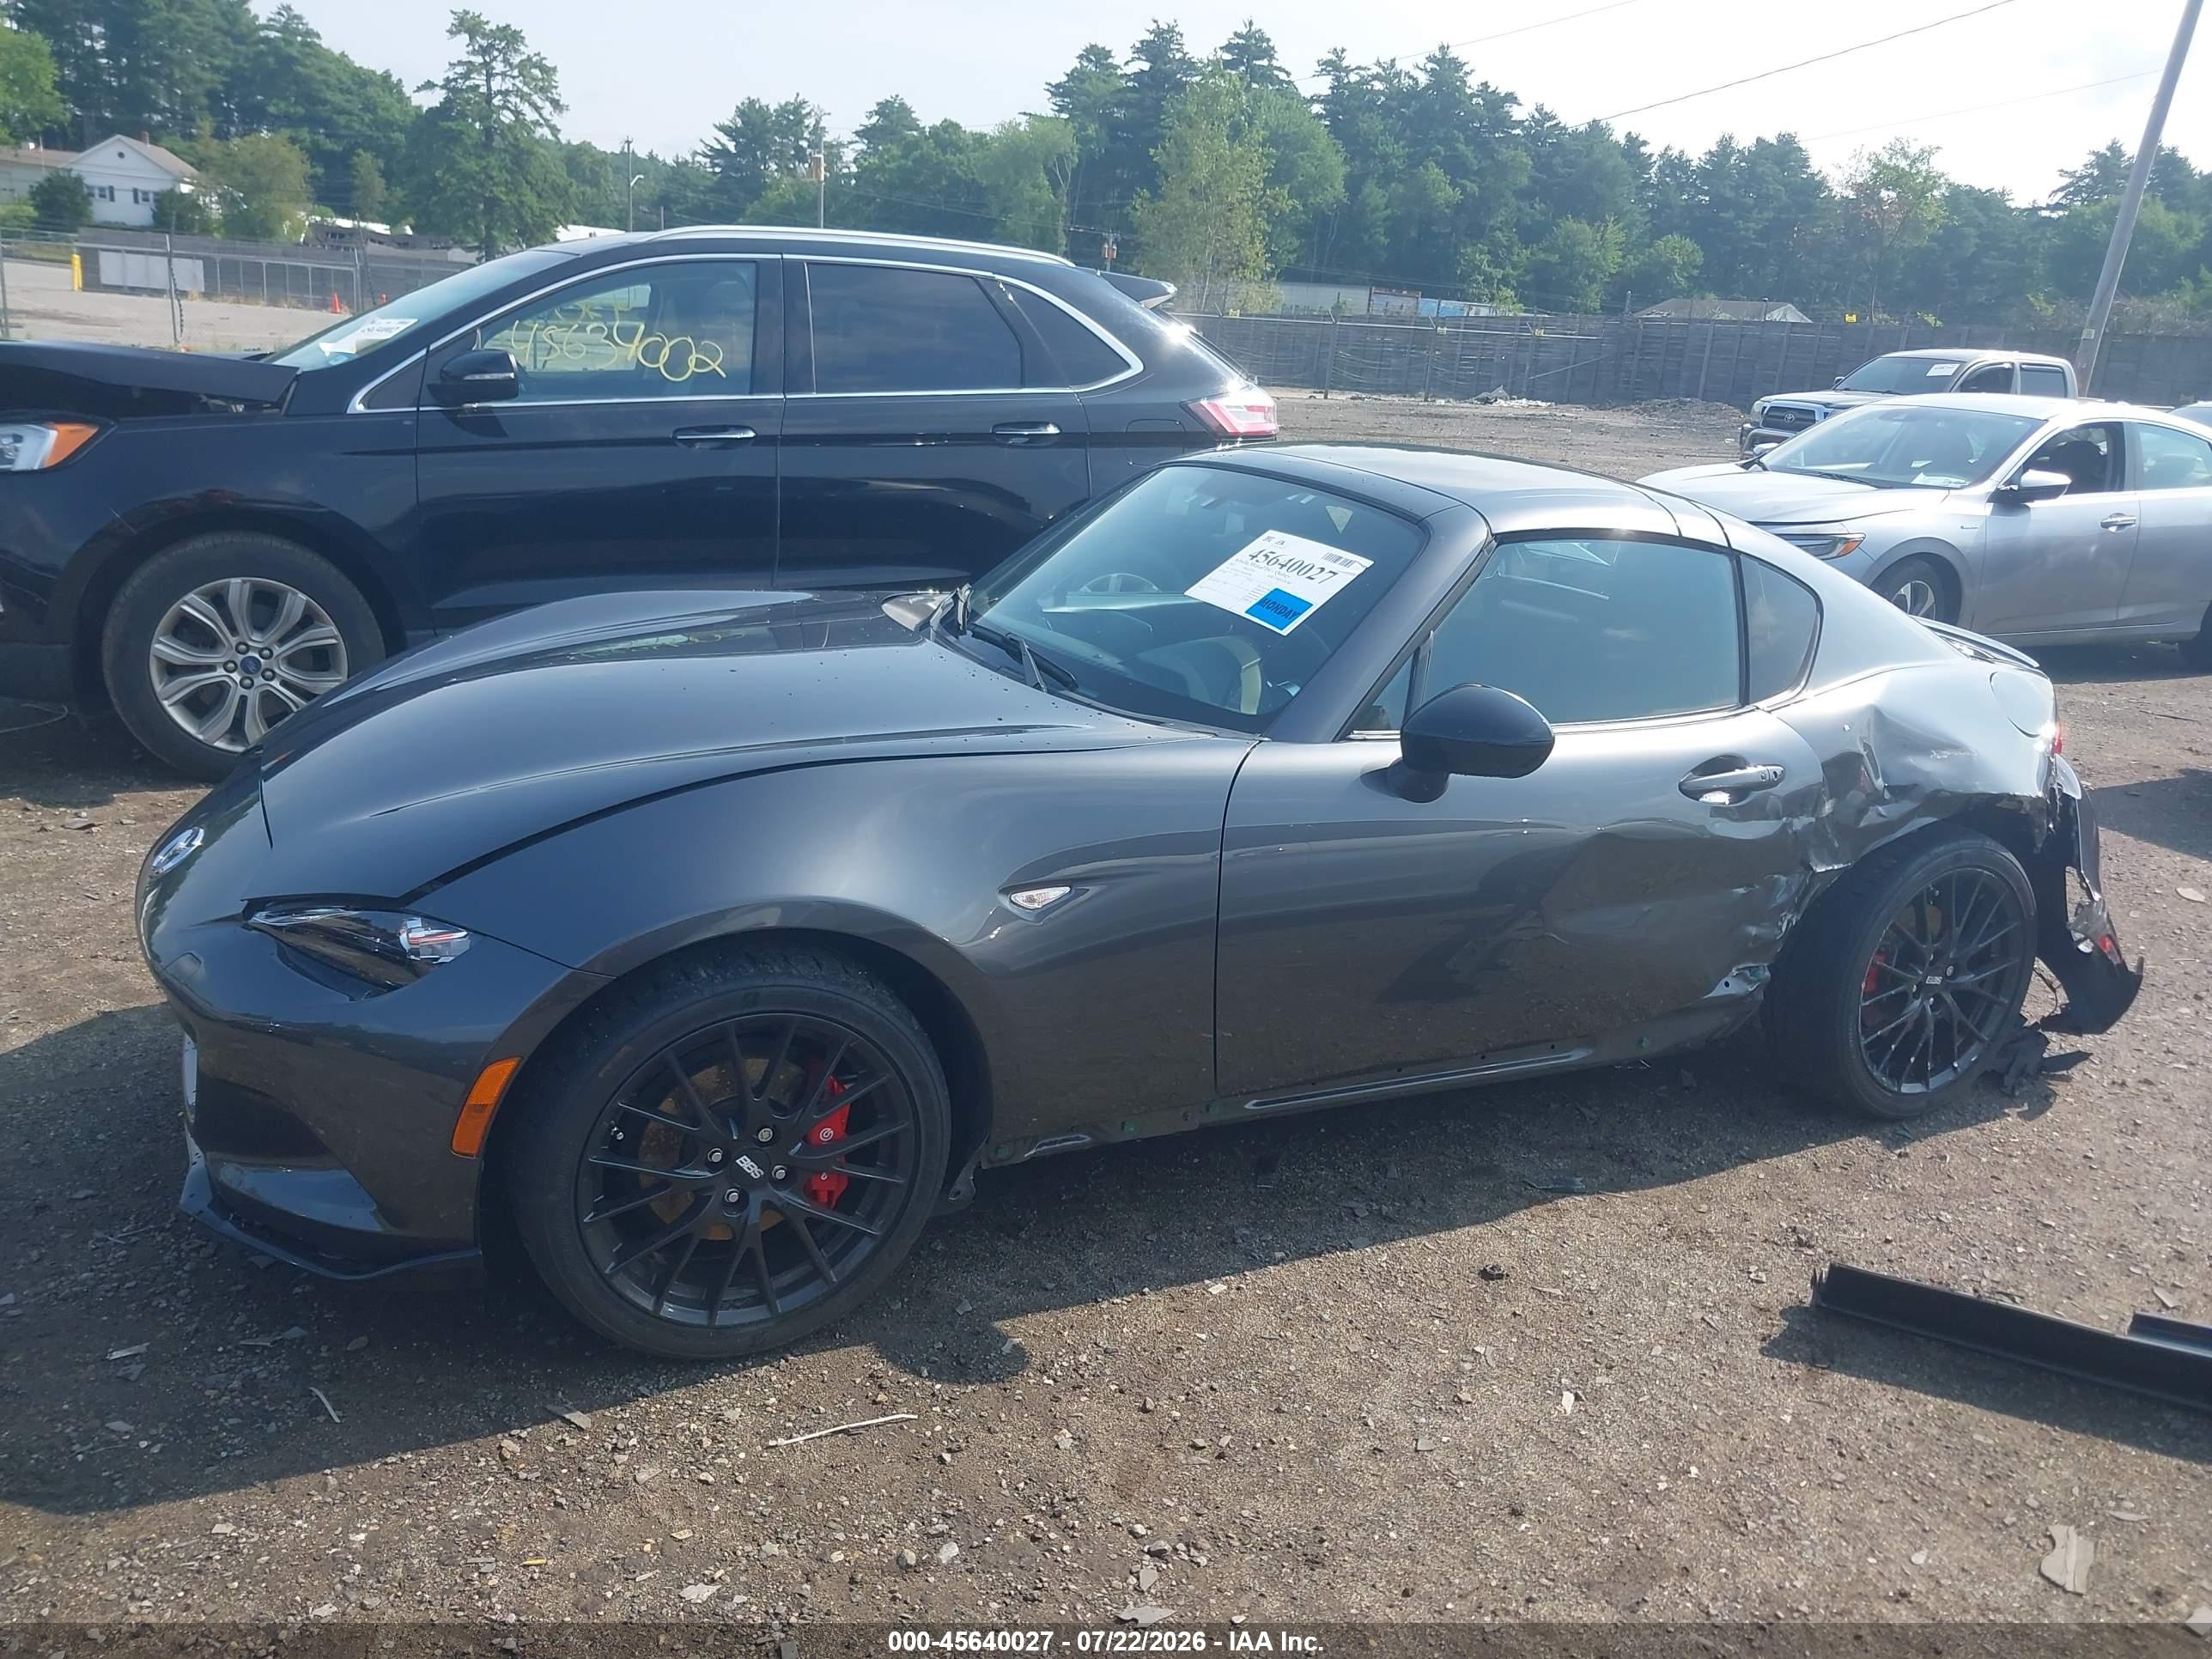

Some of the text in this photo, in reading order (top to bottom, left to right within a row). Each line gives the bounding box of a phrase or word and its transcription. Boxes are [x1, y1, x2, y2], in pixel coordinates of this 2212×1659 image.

[511, 319, 727, 382] 45634002
[1249, 548, 1339, 584] 45640027
[1257, 597, 1300, 621] MONDAY
[736, 1155, 764, 1179] BBS
